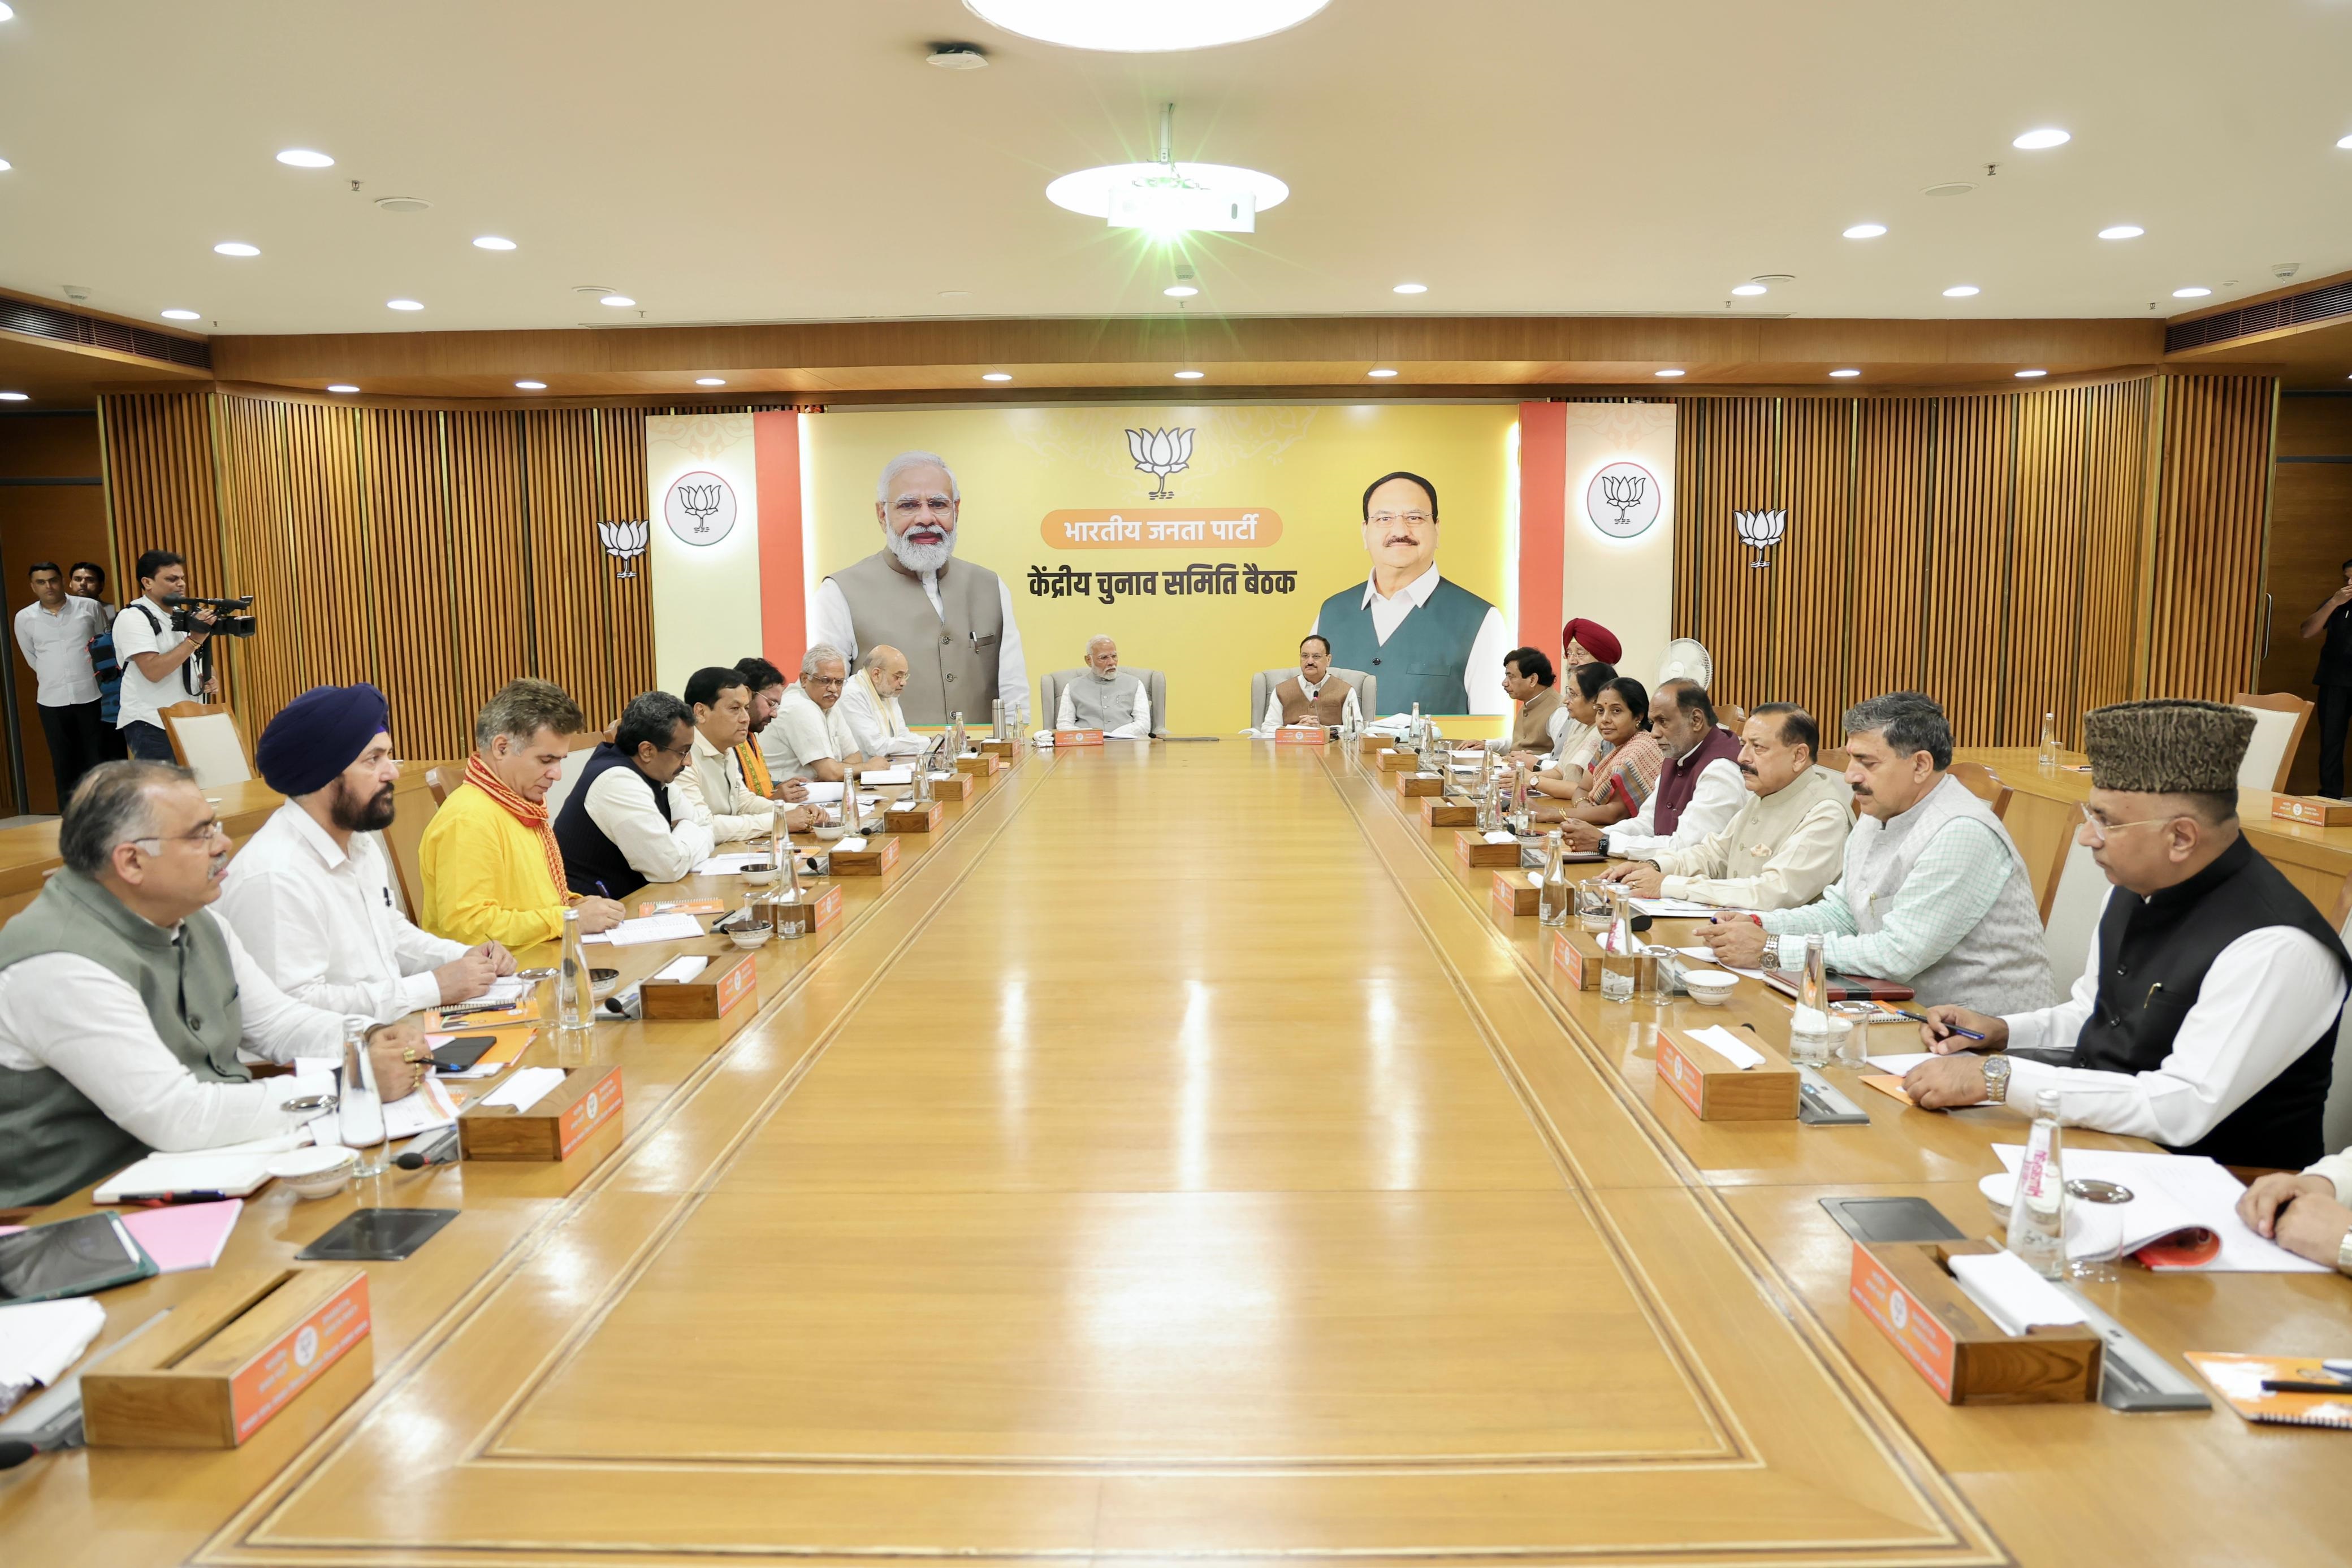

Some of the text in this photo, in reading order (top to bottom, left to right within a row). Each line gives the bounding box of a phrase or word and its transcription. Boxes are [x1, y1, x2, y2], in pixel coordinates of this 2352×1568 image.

[1064, 513, 1259, 541] भारतीय जनता पार्टी
[1027, 562, 1298, 605] केंद्रीय चुनाव समिति बैठक
